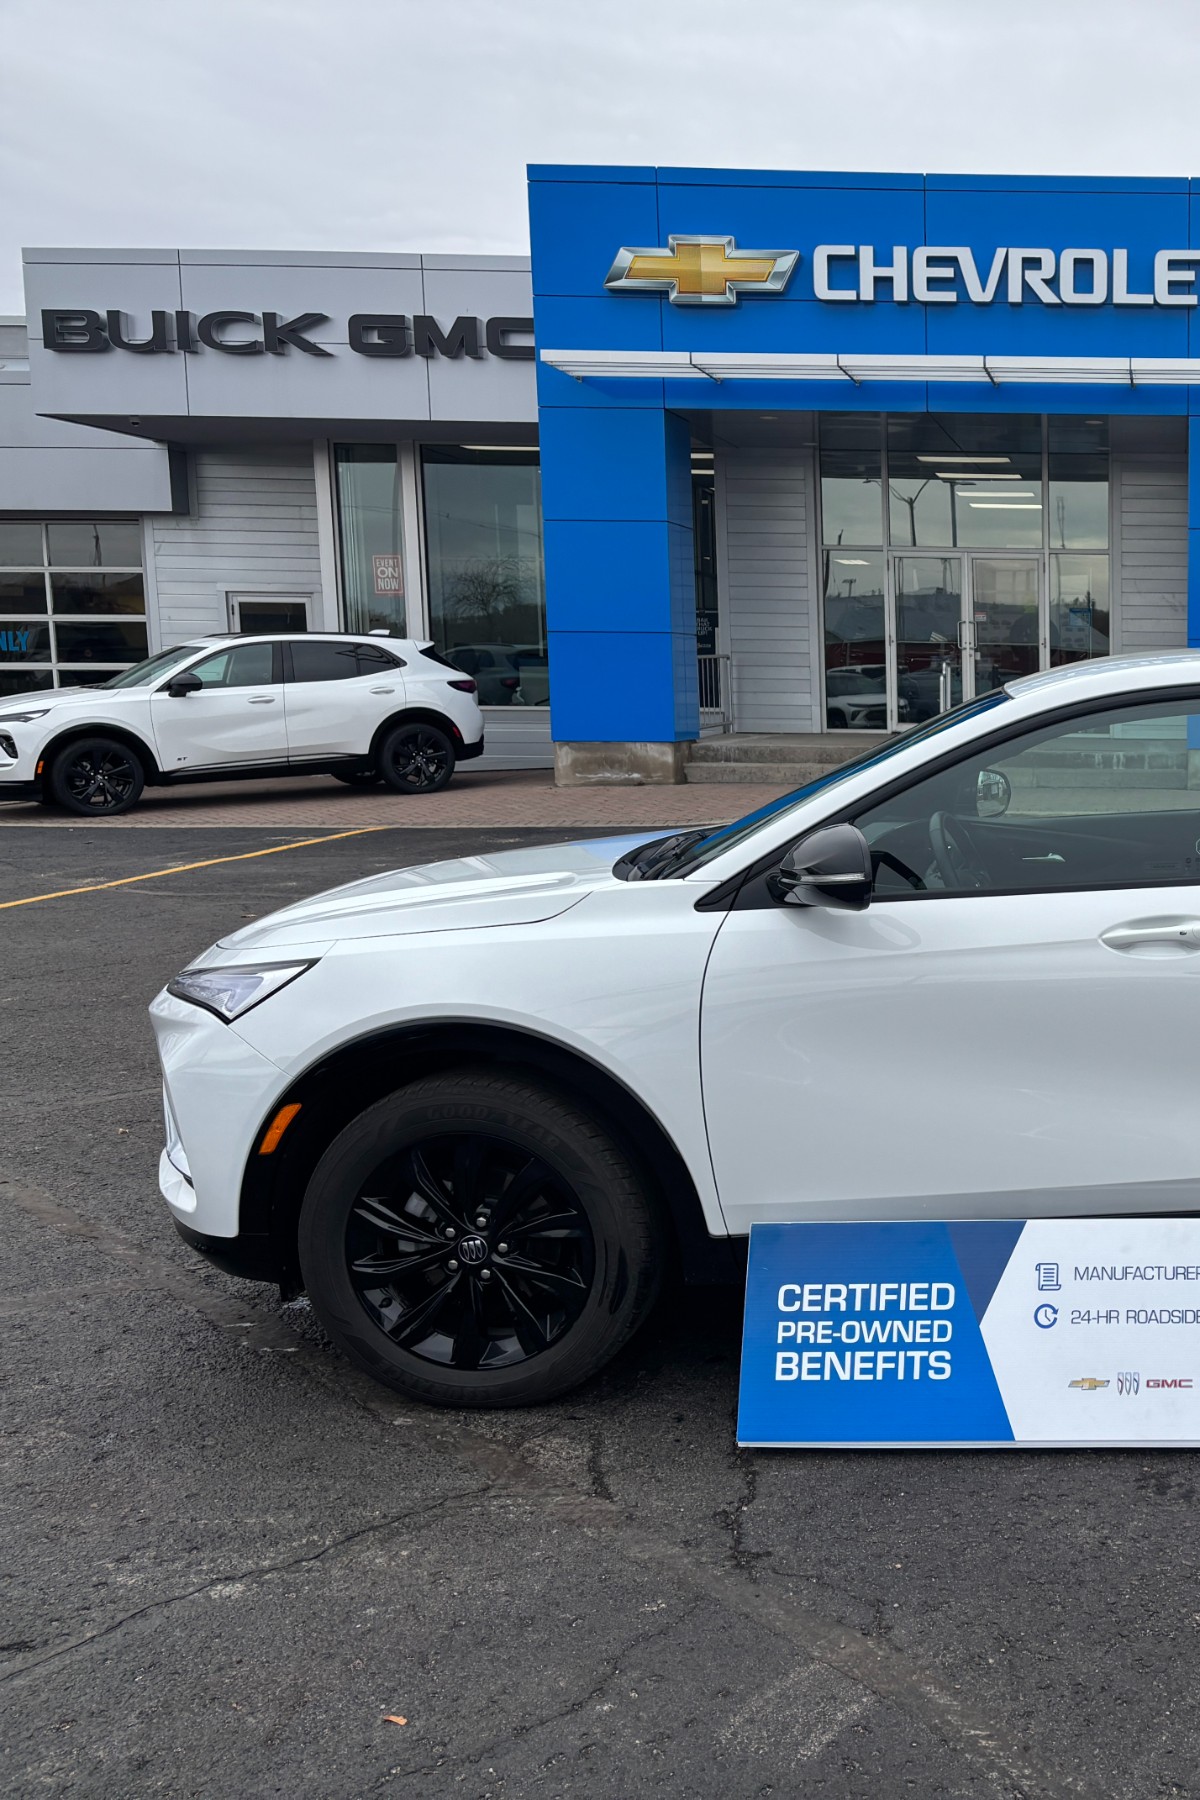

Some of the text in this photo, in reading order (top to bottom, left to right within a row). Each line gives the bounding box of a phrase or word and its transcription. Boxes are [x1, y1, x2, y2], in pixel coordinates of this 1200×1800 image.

[41, 308, 535, 359] BUICK GMC
[376, 559, 397, 567] EVENT
[377, 567, 398, 578] ON
[378, 578, 399, 590] NOW
[777, 1283, 955, 1311] CERTIFIED
[1070, 1310, 1120, 1325] 24-HR
[777, 1320, 952, 1343] PRE-OWNED
[775, 1350, 952, 1381] BENEFITS
[1146, 1379, 1193, 1389] GMC
